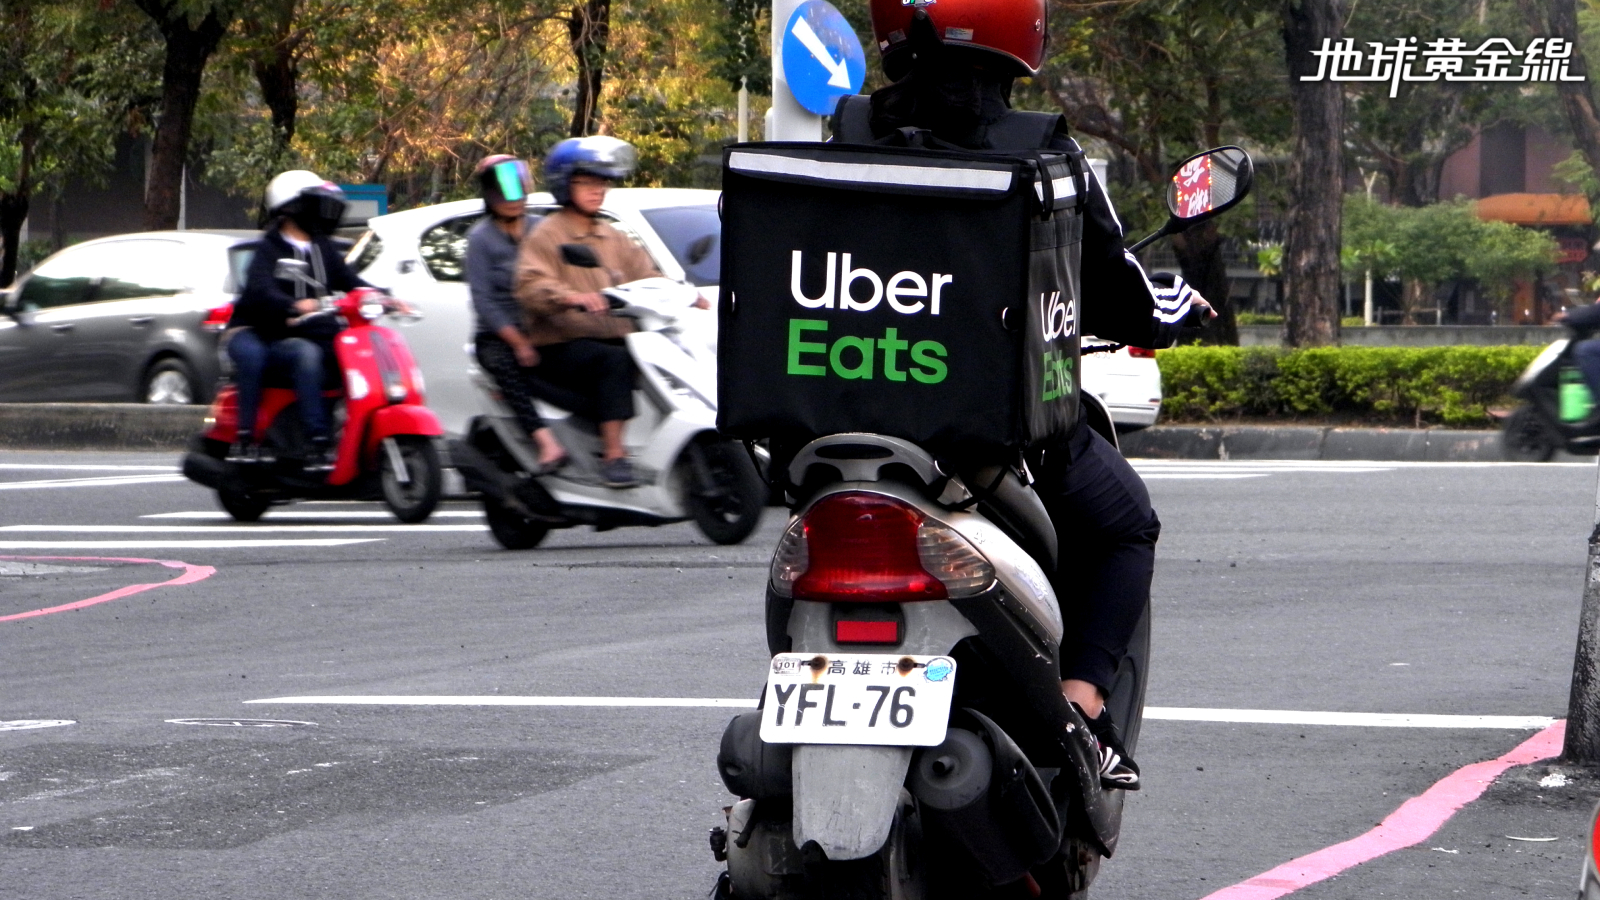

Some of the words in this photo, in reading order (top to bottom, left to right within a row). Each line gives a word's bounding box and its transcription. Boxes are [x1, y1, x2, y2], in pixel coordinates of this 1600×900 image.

[790, 249, 953, 315] Uber
[787, 318, 948, 384] Eats
[1042, 350, 1073, 402] Eats
[778, 660, 796, 669] 101
[827, 660, 897, 675] 高雄市
